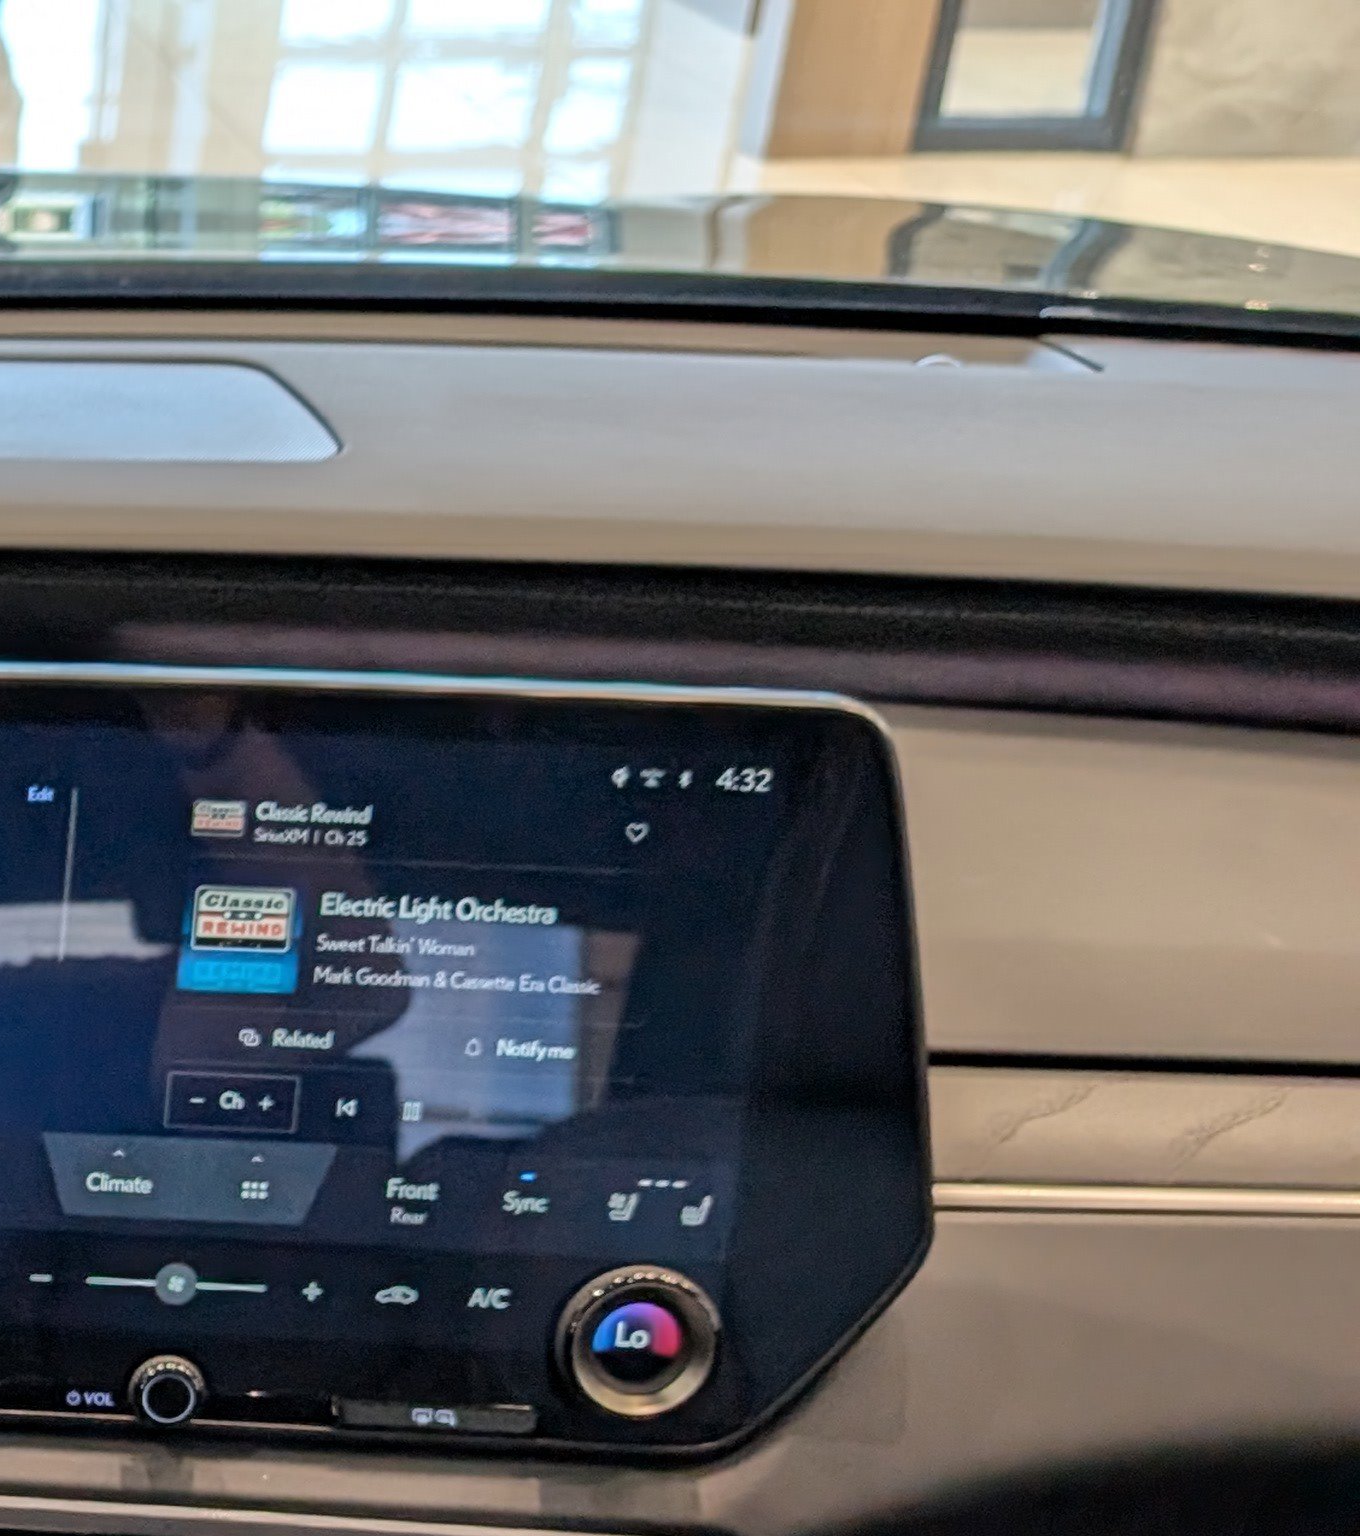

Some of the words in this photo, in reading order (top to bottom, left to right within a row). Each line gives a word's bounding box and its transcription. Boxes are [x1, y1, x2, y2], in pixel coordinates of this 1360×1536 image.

[715, 767, 774, 793] 4:32
[27, 785, 55, 802] Edit
[255, 801, 309, 823] Classic
[311, 802, 374, 825] Rewind
[347, 830, 368, 847] 25
[204, 894, 285, 910] Classic
[320, 891, 395, 919] Electric
[398, 895, 453, 925] Light
[455, 897, 558, 926] Orchestra
[202, 921, 283, 935] REWIND
[315, 932, 366, 953] Sweet
[417, 937, 475, 957] Woman
[312, 965, 354, 985] Mark
[355, 966, 430, 988] Goodman
[433, 970, 447, 989] &
[450, 971, 515, 993] Cassette
[518, 974, 545, 993] Era
[272, 1028, 335, 1051] Related
[495, 1038, 546, 1062] Notify
[547, 1045, 576, 1061] me
[219, 1089, 246, 1111] Ch
[86, 1171, 153, 1196] Climate
[386, 1177, 440, 1202] Front
[502, 1189, 550, 1215] Sync
[390, 1206, 428, 1226] Rear
[467, 1287, 513, 1310] A/C
[614, 1320, 652, 1350] Lo
[83, 1391, 115, 1408] VOL
